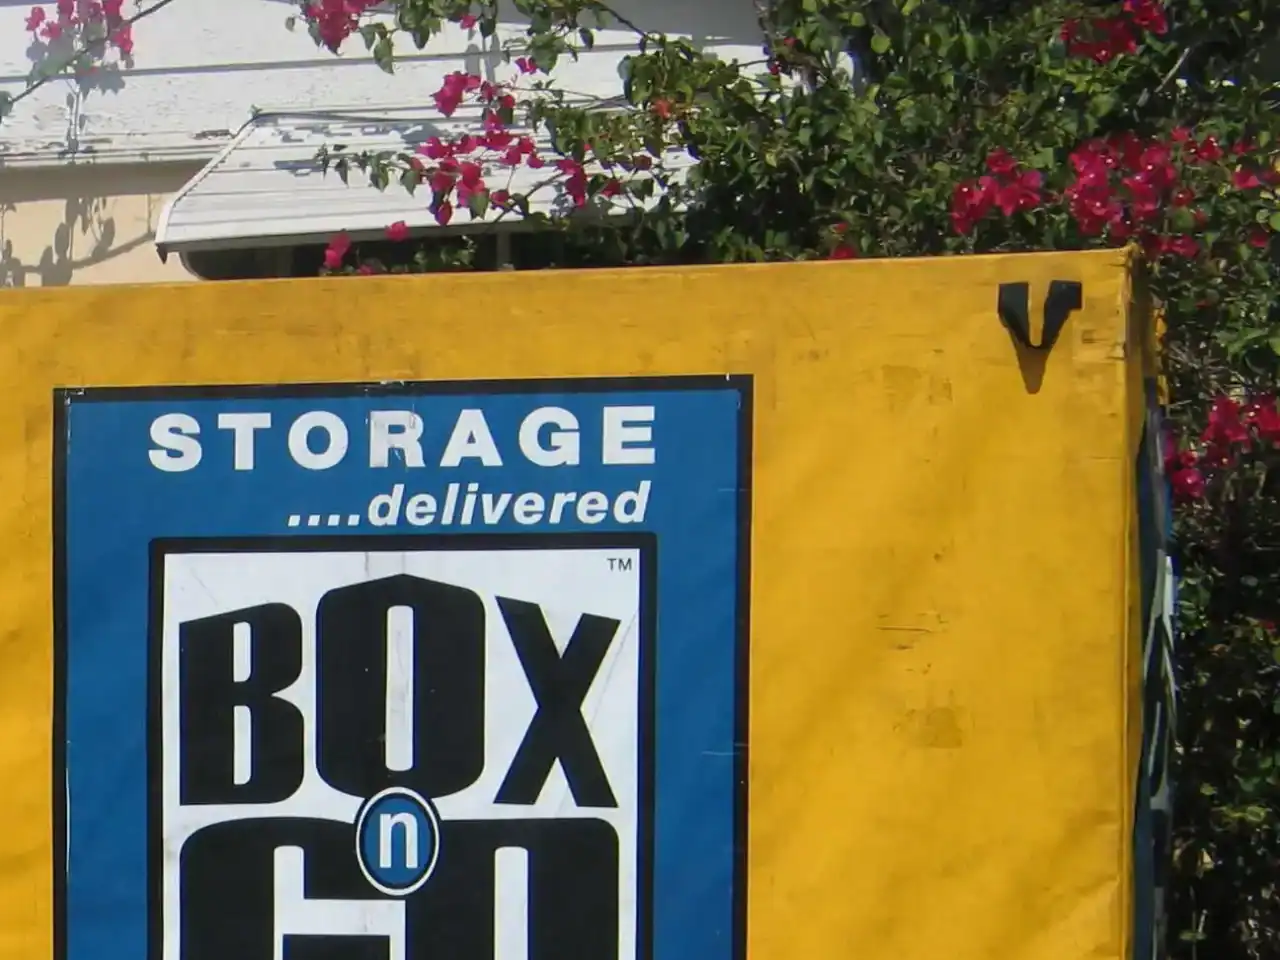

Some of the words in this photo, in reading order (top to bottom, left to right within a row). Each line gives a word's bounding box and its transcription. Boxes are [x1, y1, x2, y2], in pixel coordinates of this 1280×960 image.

[148, 405, 656, 472] STORAGE
[606, 557, 633, 572] TM
[179, 573, 622, 809] BOX
[379, 811, 419, 870] n
